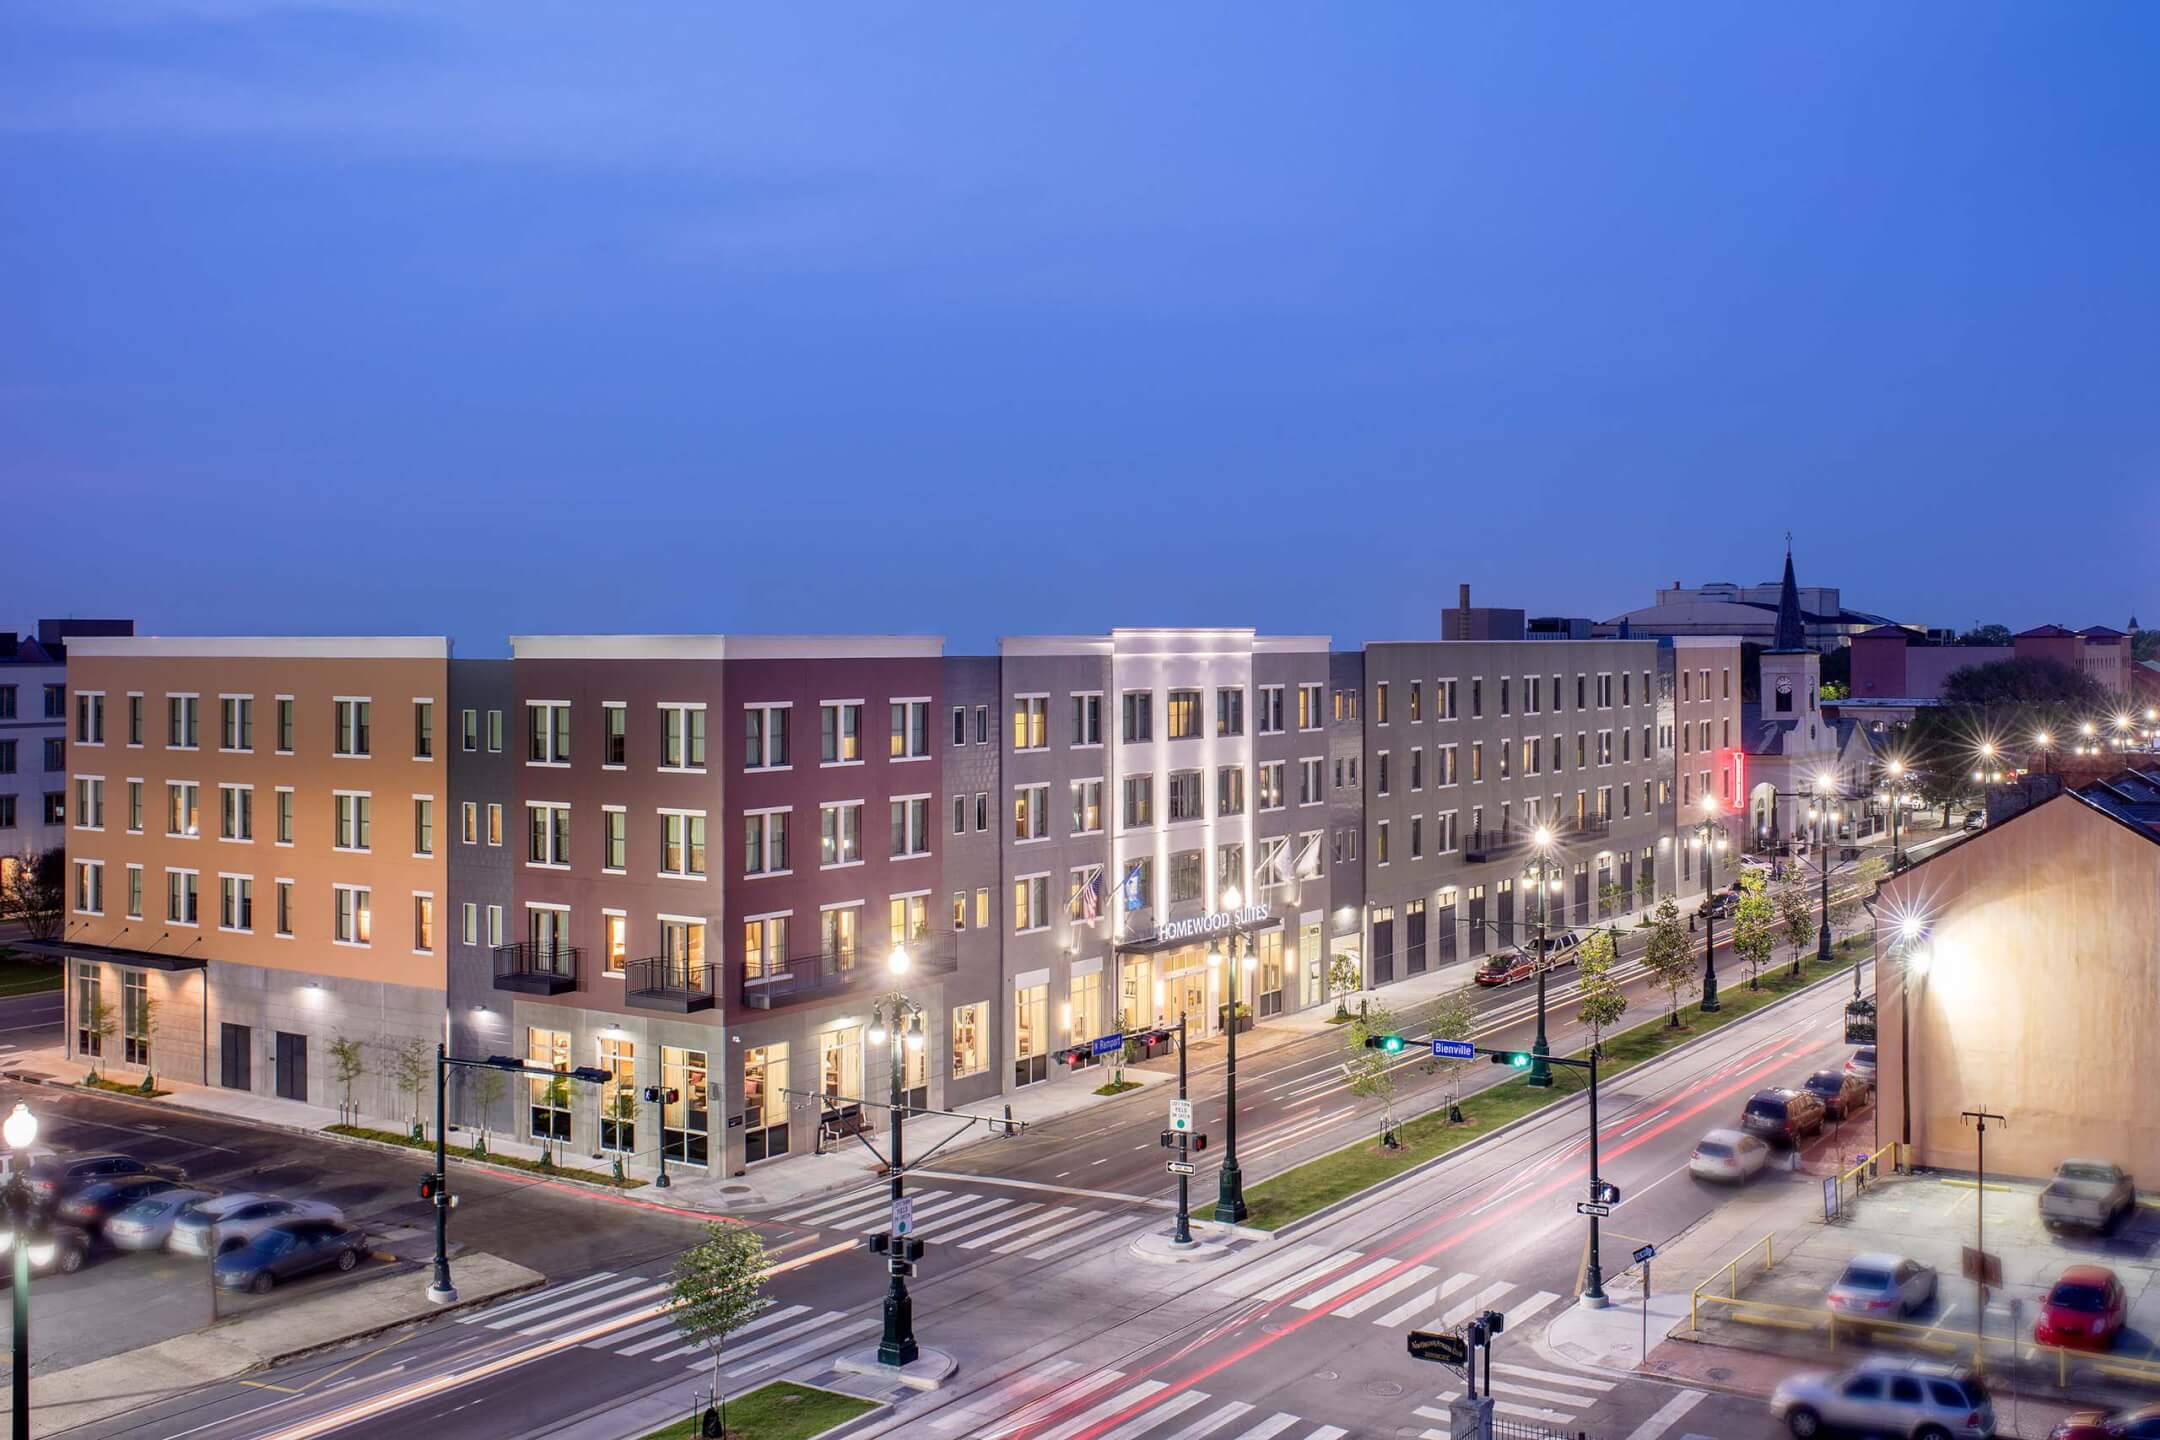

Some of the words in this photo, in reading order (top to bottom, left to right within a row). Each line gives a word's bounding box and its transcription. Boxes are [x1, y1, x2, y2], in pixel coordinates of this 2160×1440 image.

[1160, 912, 1229, 940] HOMEWOOD
[1234, 904, 1268, 925] SUITES
[1435, 1042, 1471, 1055] Bienville
